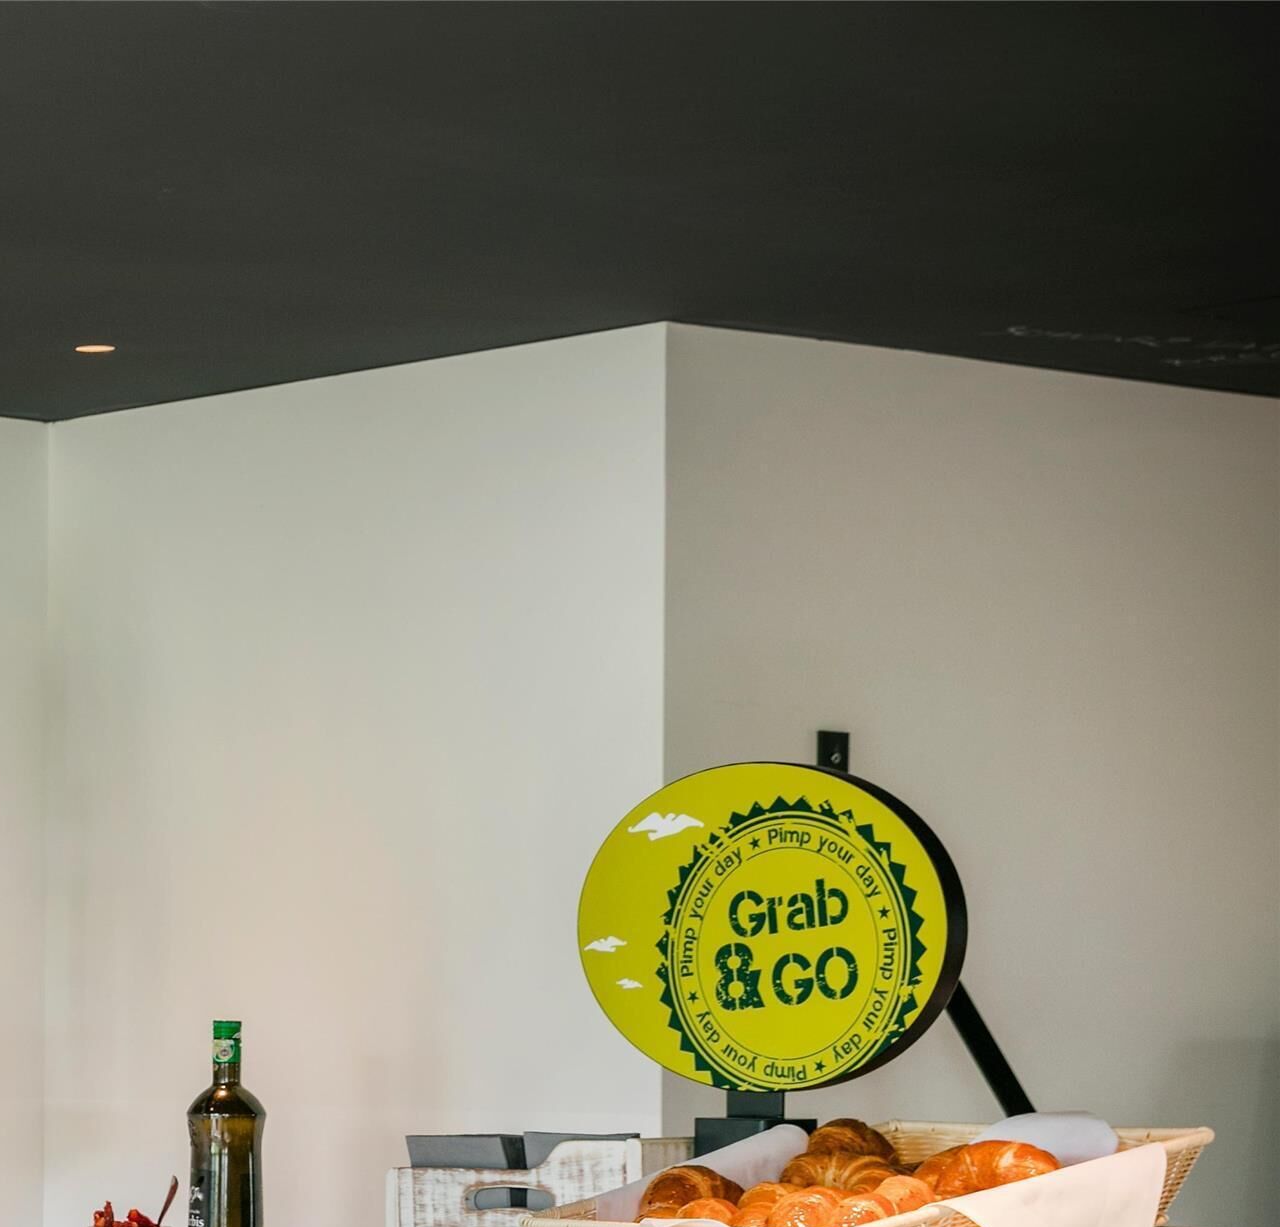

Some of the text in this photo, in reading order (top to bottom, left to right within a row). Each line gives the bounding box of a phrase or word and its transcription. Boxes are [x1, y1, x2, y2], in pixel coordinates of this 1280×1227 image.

[768, 828, 881, 898] Pimp your day
[681, 847, 742, 977] Pimp your day
[729, 879, 848, 937] Grab
[715, 942, 859, 1011] & GO
[833, 927, 897, 1063] Pimp your day
[696, 1013, 807, 1081] Pimp your day
